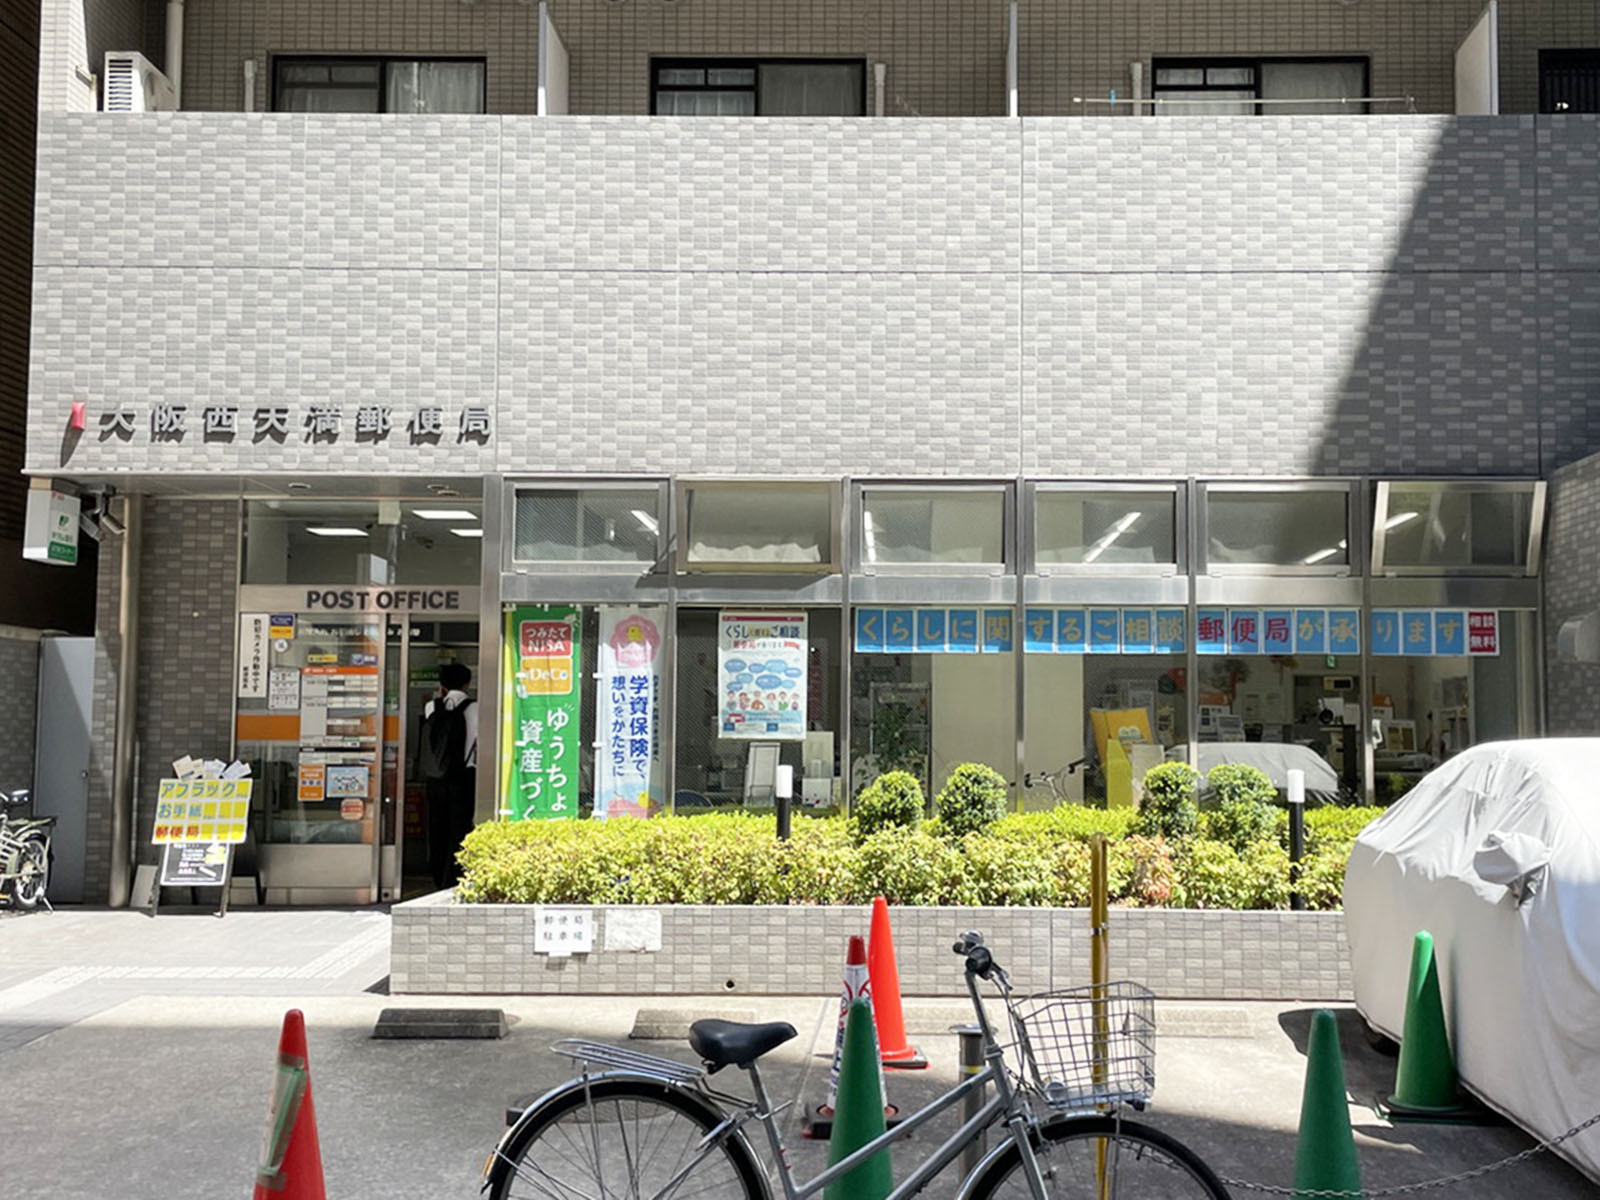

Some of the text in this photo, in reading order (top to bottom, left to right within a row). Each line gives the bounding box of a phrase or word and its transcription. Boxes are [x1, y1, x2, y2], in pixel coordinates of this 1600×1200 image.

[100, 403, 492, 438] 大阪西天満郵便局
[306, 590, 460, 610] POST OFFICE
[1470, 614, 1495, 628] 相談
[526, 626, 568, 639] つみたて
[863, 616, 1461, 645] くらしに関するご相談 郵便局が承ります
[528, 640, 566, 653] NISA
[1470, 634, 1496, 649] 無料
[611, 676, 626, 776] 想いをかたちに
[546, 708, 569, 820] ゆうちょ
[161, 782, 236, 798] アフラック
[158, 803, 202, 818] お手紙
[156, 825, 199, 839] 郵便局
